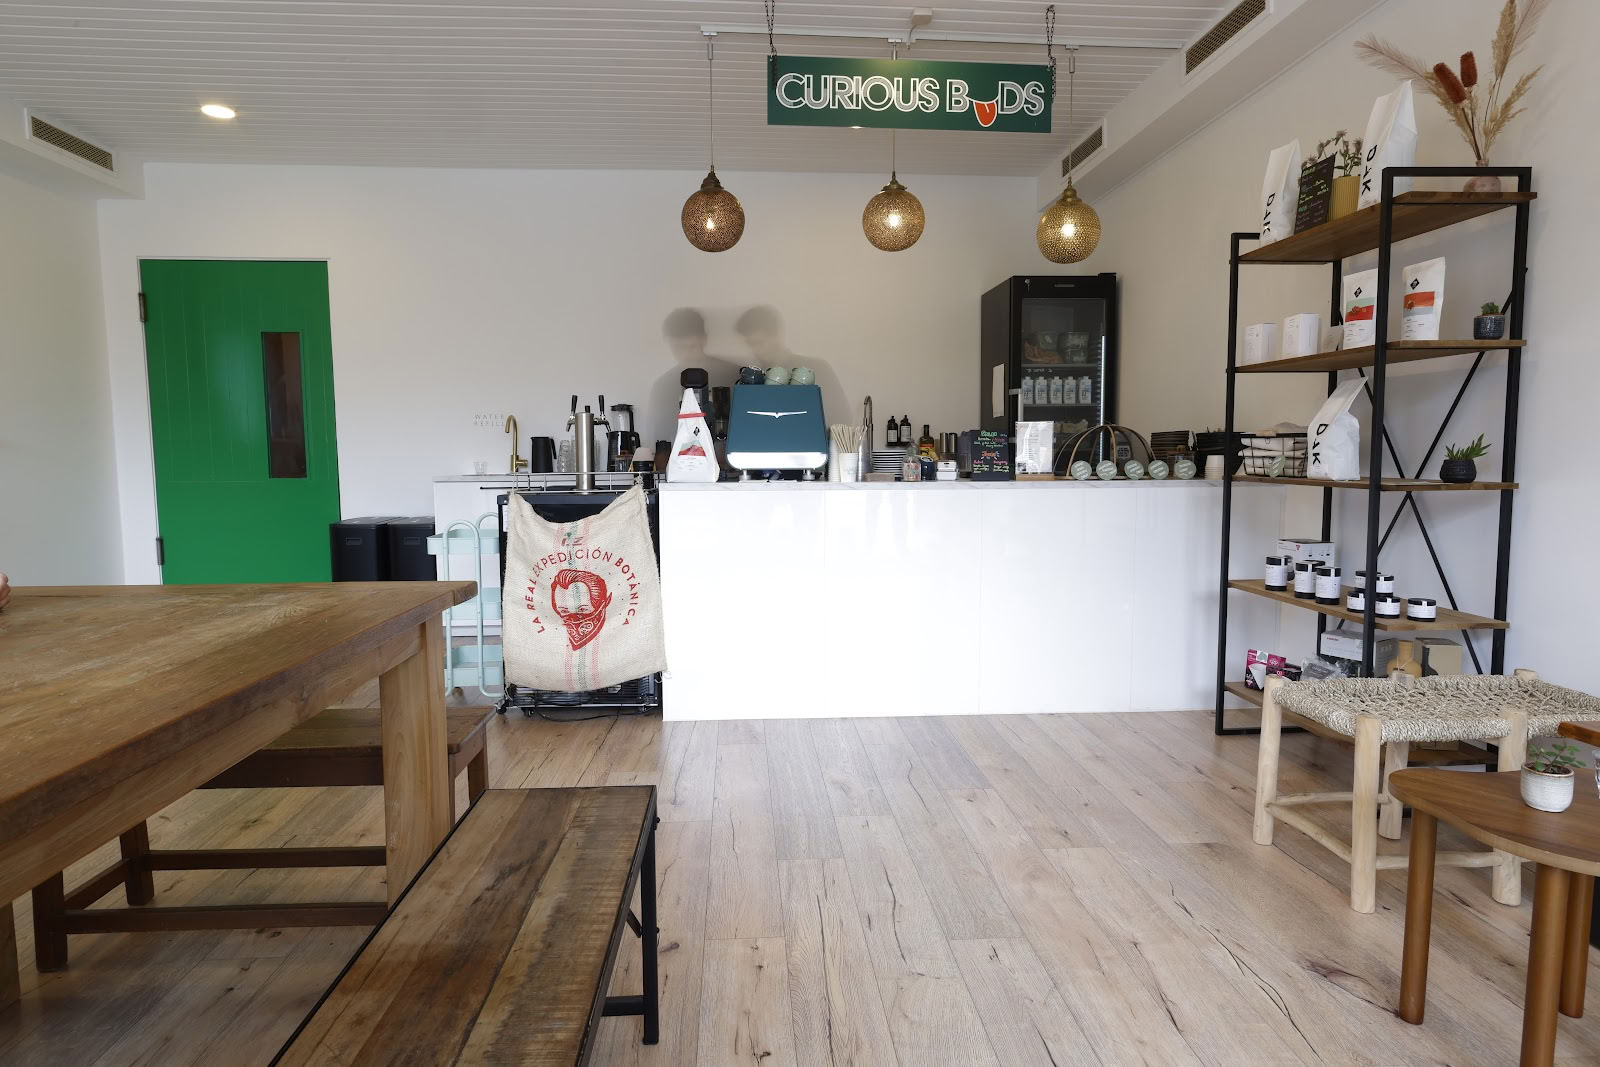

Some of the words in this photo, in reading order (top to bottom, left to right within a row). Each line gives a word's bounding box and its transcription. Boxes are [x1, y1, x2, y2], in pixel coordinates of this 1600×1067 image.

[776, 73, 939, 112] CURIOUS
[532, 546, 613, 578] EXPEDICIÓN
[525, 578, 537, 611] REAL
[614, 557, 641, 626] BOTÁNICA
[532, 616, 546, 634] LA
